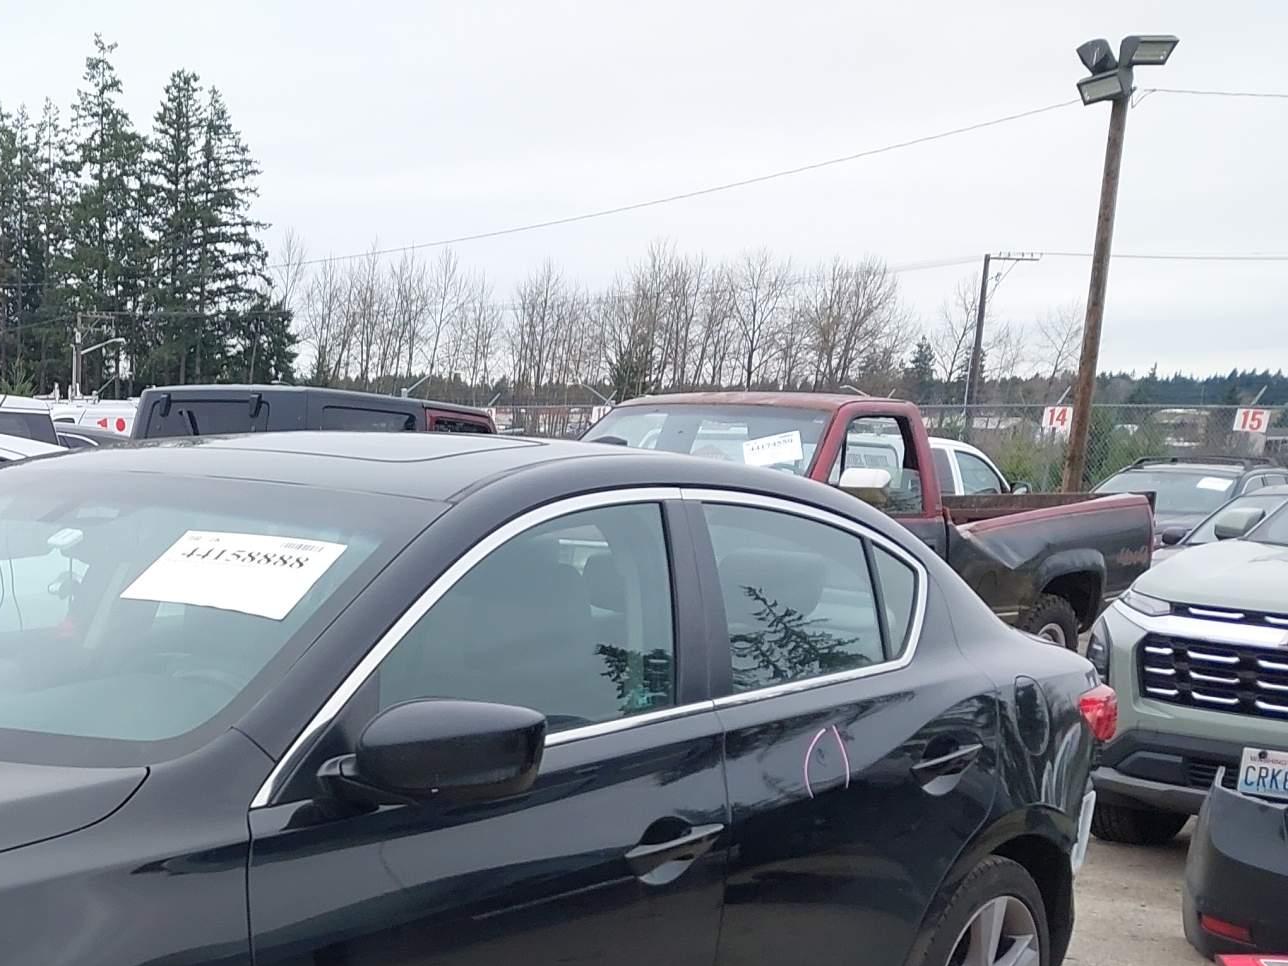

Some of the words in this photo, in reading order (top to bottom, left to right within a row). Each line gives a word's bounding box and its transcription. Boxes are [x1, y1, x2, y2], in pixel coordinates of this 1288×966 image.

[1048, 408, 1067, 426] 14
[1241, 411, 1262, 431] 15
[180, 547, 310, 569] 44158888
